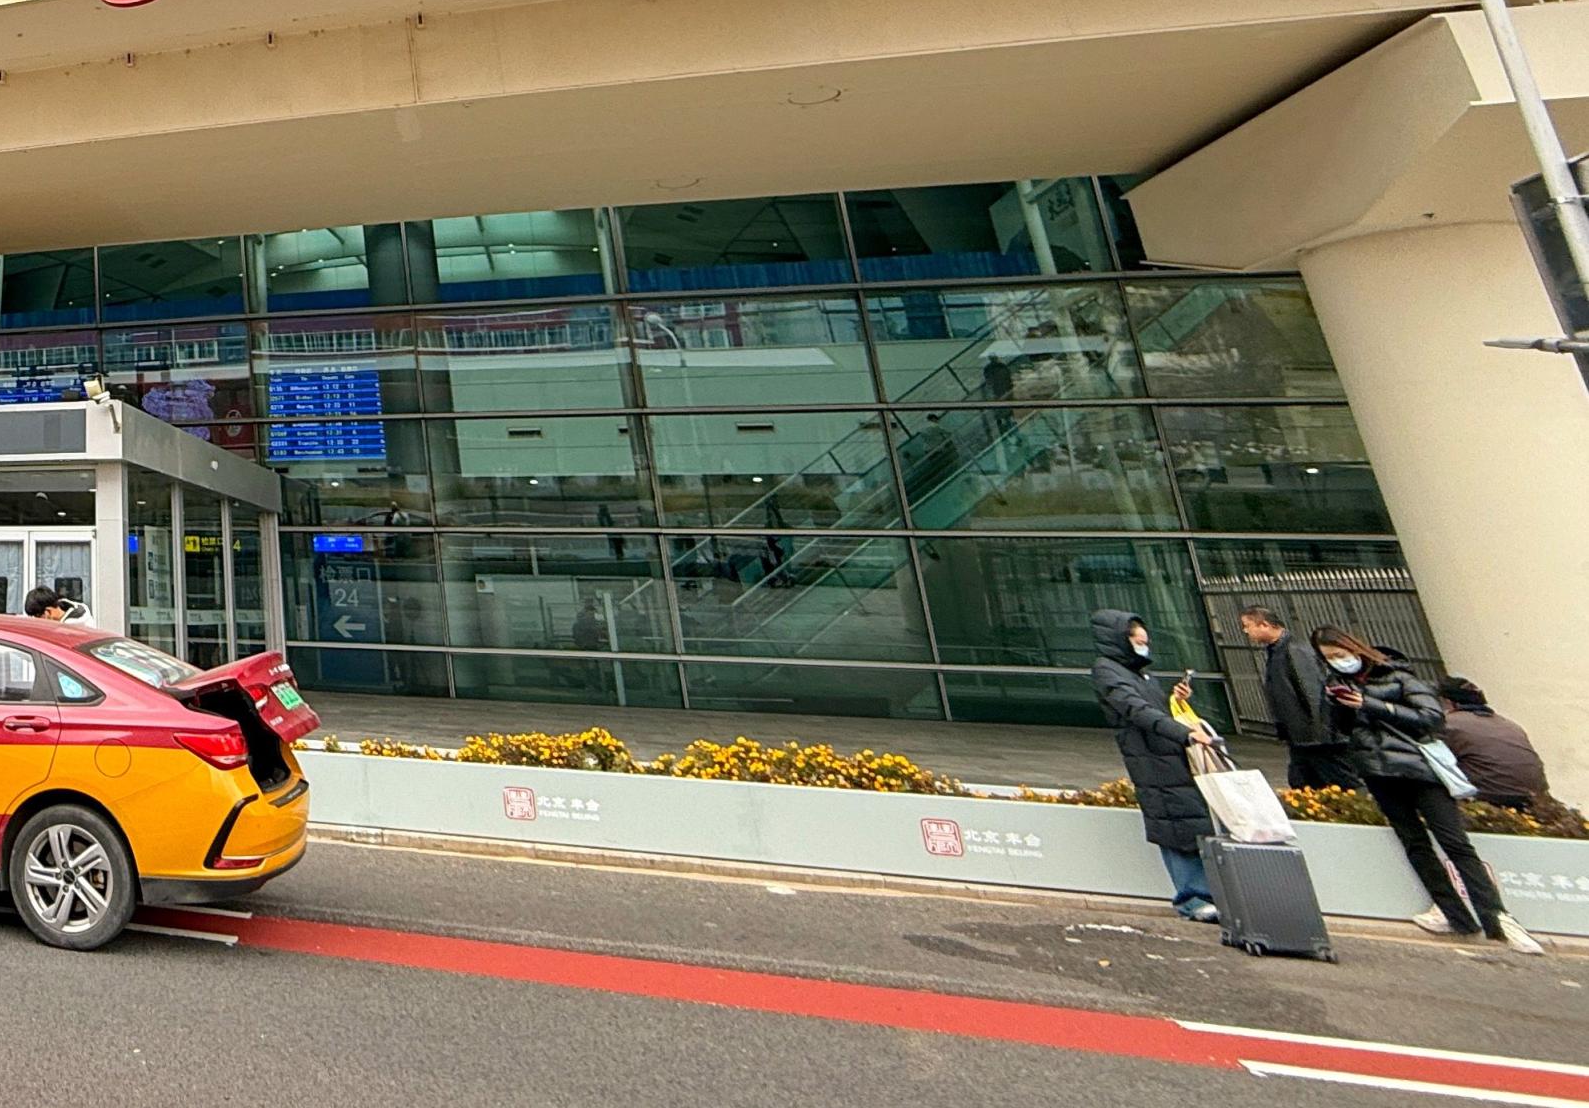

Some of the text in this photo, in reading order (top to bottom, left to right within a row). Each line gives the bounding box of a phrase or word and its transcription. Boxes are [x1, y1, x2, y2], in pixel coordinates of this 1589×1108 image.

[319, 564, 372, 584] 检票口
[334, 588, 360, 608] 24
